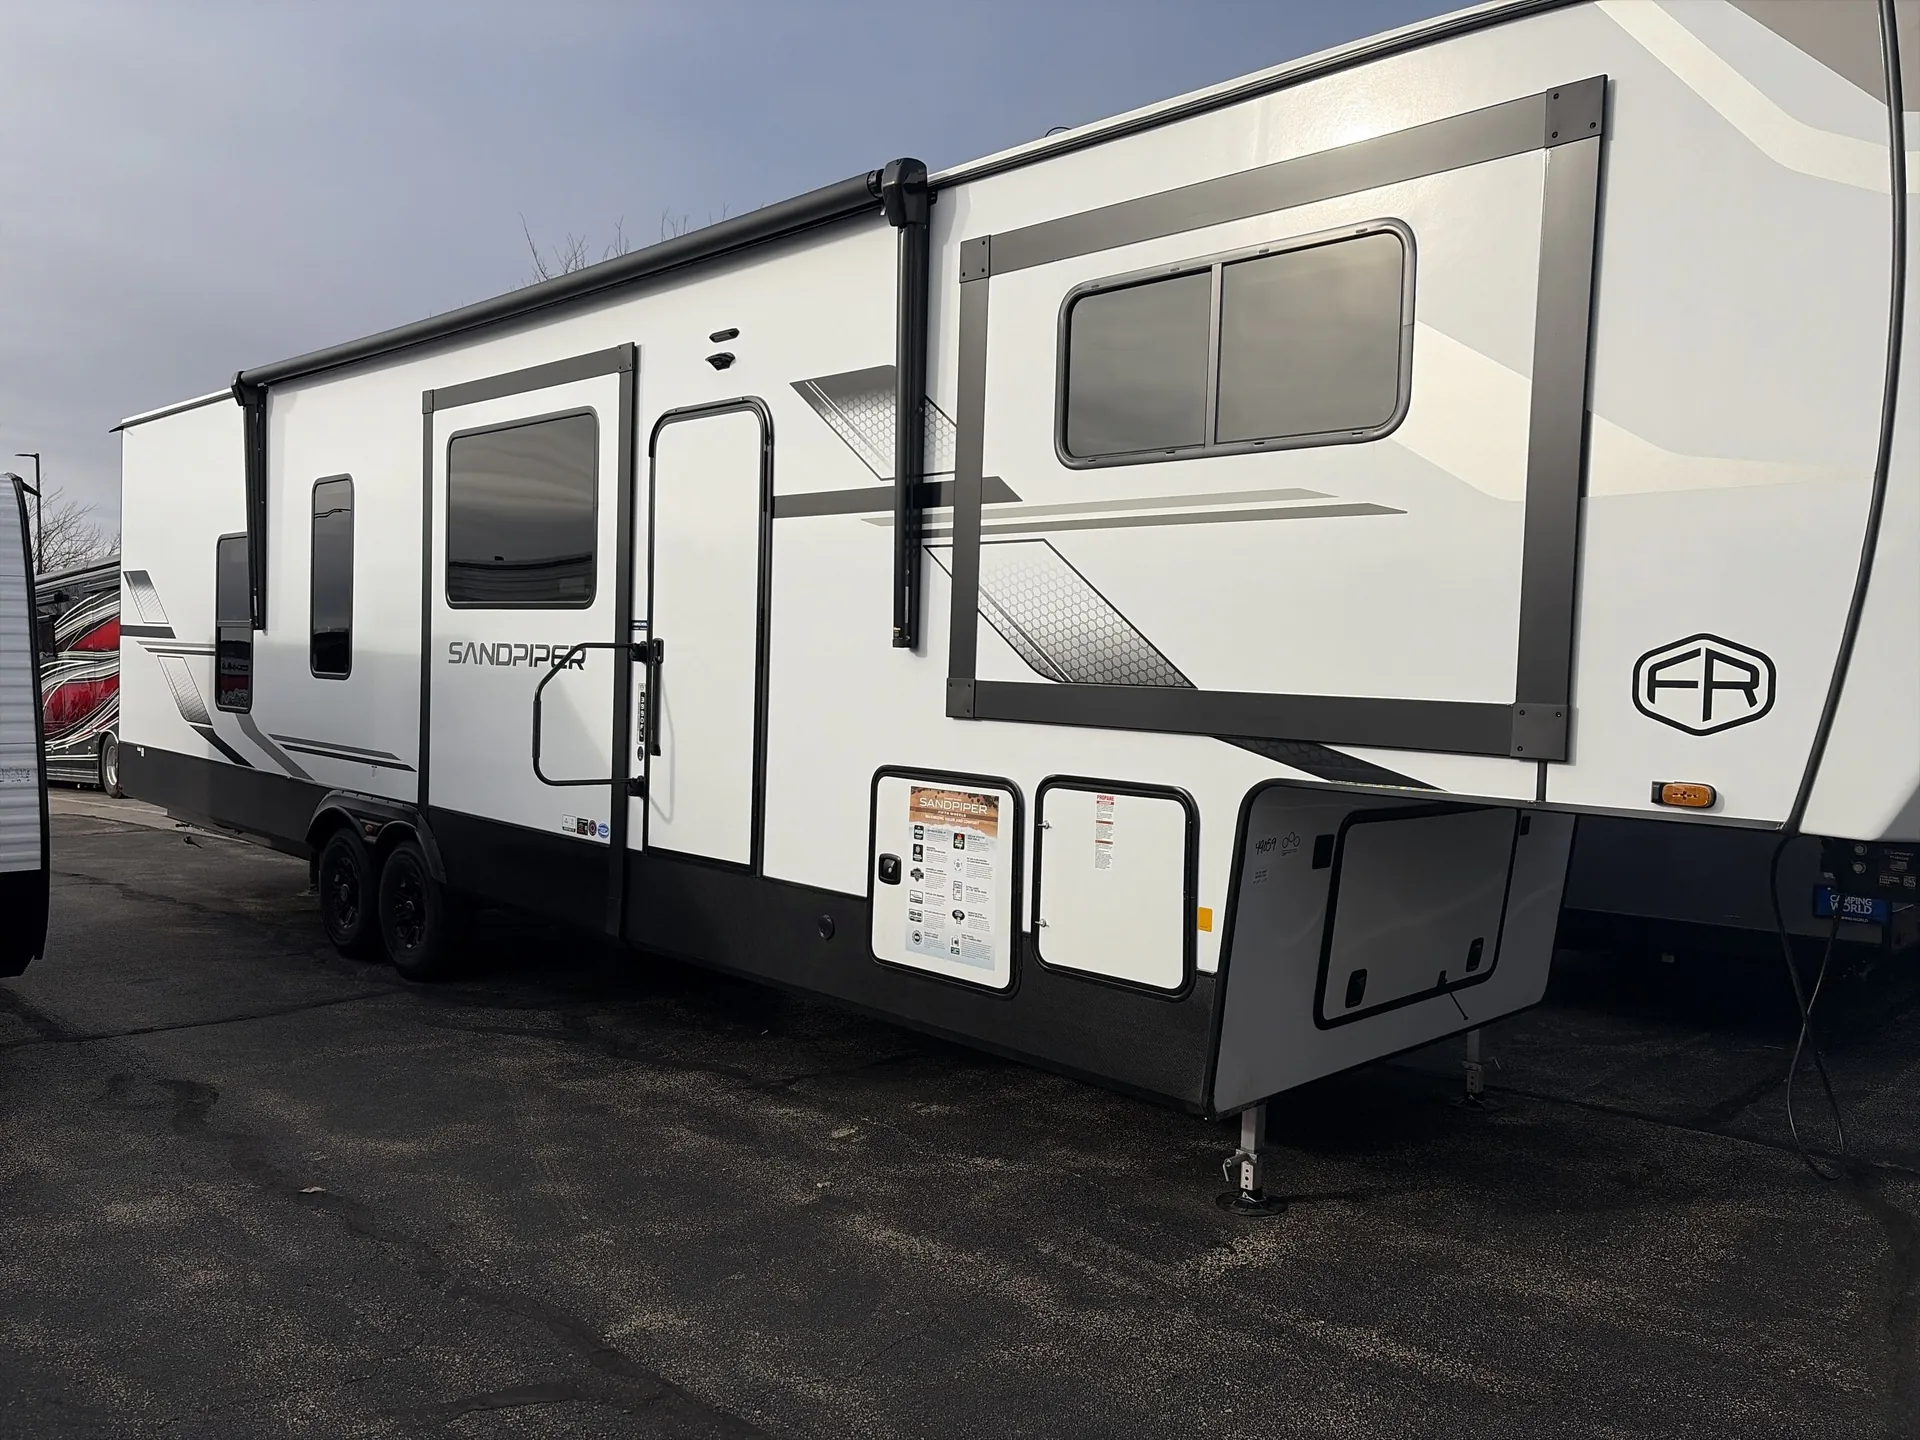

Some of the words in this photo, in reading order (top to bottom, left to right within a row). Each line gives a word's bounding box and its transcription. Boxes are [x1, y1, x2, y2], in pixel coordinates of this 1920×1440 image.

[448, 641, 587, 670] SANDPIPER
[919, 797, 988, 815] SANDPIPER
[1829, 901, 1873, 915] WORLD
